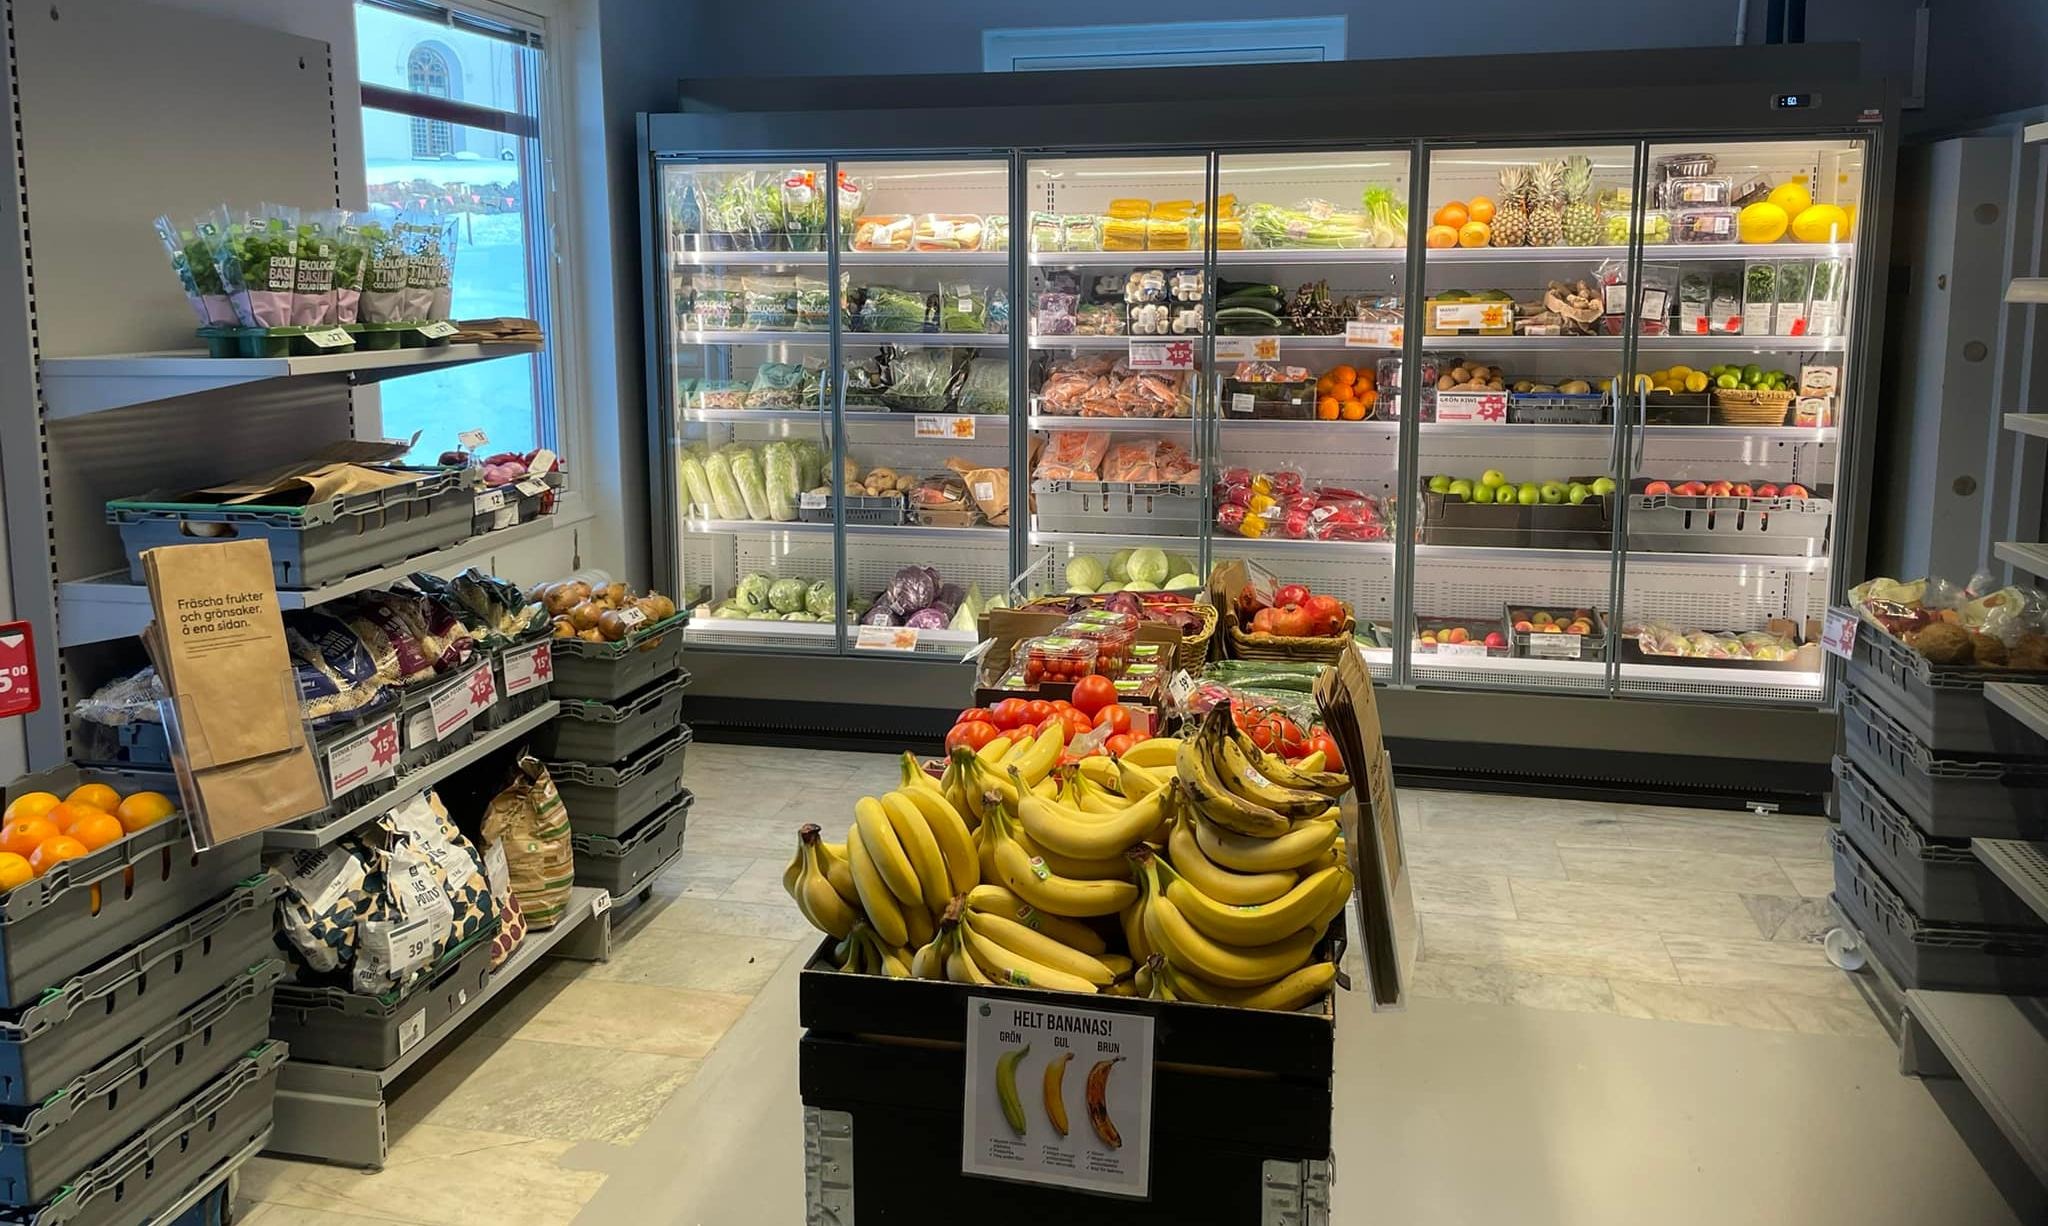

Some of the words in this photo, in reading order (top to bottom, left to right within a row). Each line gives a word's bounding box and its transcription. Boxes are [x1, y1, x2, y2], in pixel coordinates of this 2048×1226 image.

[178, 596, 224, 610] Fräscha
[226, 592, 264, 605] frukter
[180, 610, 202, 623] och
[204, 605, 262, 622] grönsaker,
[182, 624, 190, 635] å
[193, 624, 215, 635] ena
[218, 620, 251, 631] sidan.
[408, 940, 424, 958] 39
[1013, 1010, 1044, 1029] HELT
[1047, 1013, 1113, 1037] BANANAS!
[1000, 1030, 1022, 1043] GRÖN
[1054, 1036, 1070, 1048] GUL
[1097, 1041, 1120, 1053] BRUN
